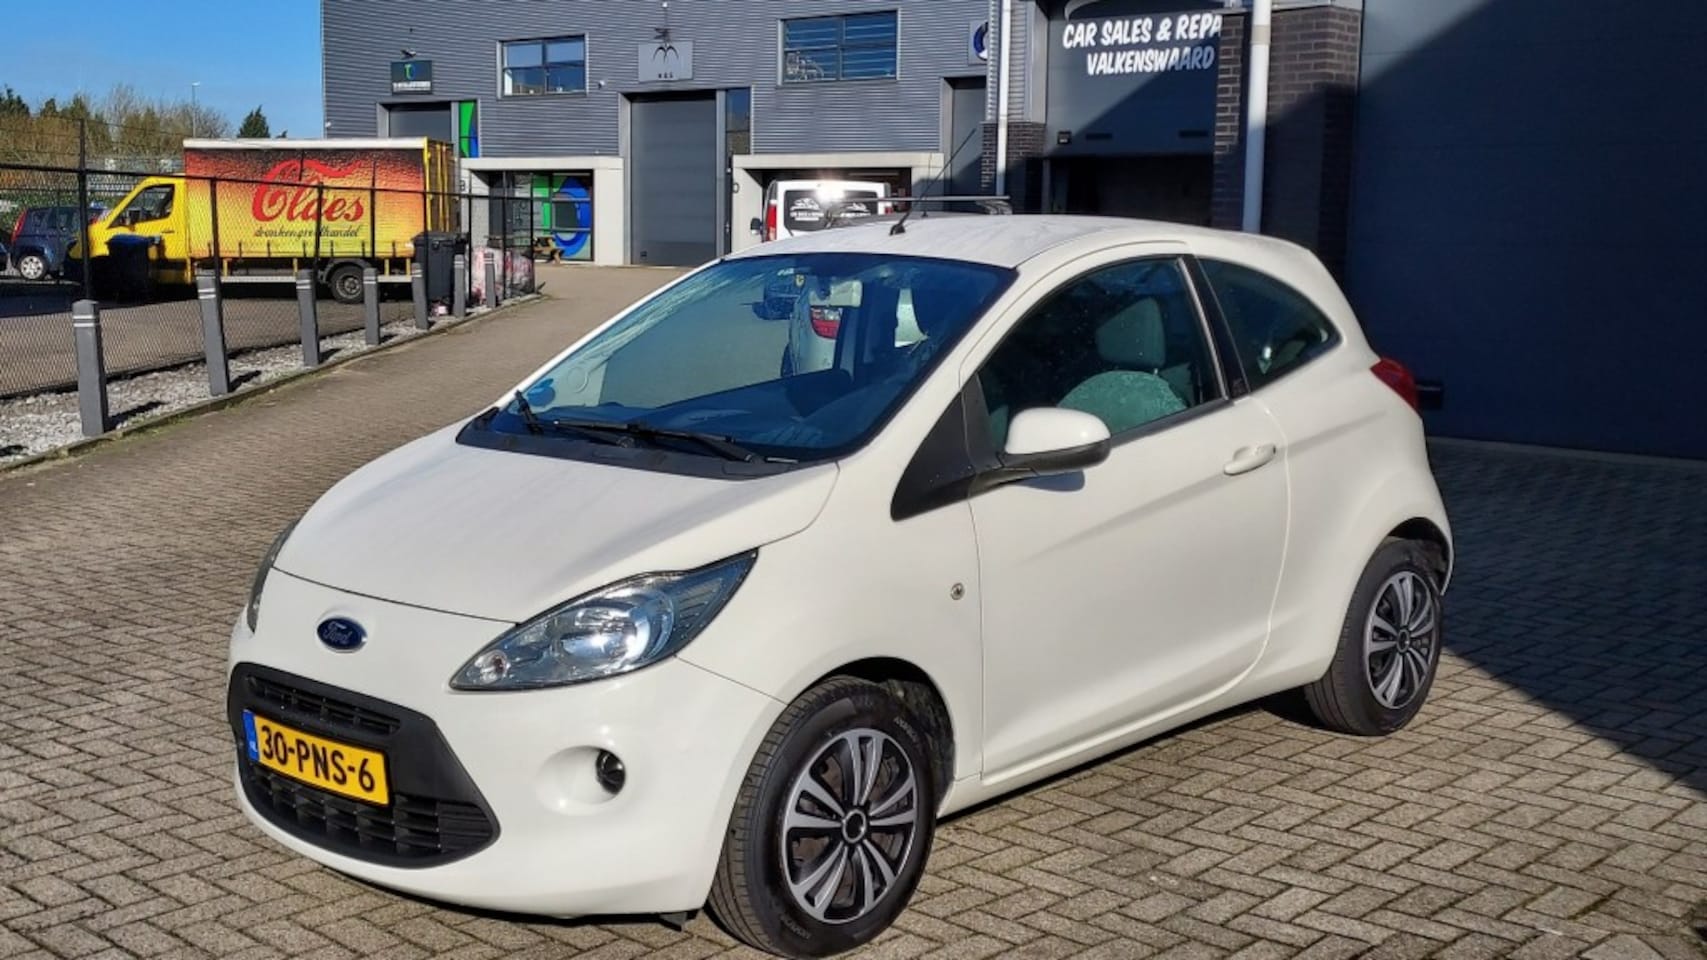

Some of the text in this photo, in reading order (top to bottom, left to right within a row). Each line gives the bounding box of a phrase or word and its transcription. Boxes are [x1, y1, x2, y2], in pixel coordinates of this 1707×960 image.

[1062, 12, 1223, 49] CAR SALES & REPA
[1087, 46, 1214, 75] VALKENSWAARD
[252, 158, 364, 222] Claes
[261, 725, 375, 792] 30-PNS-6
